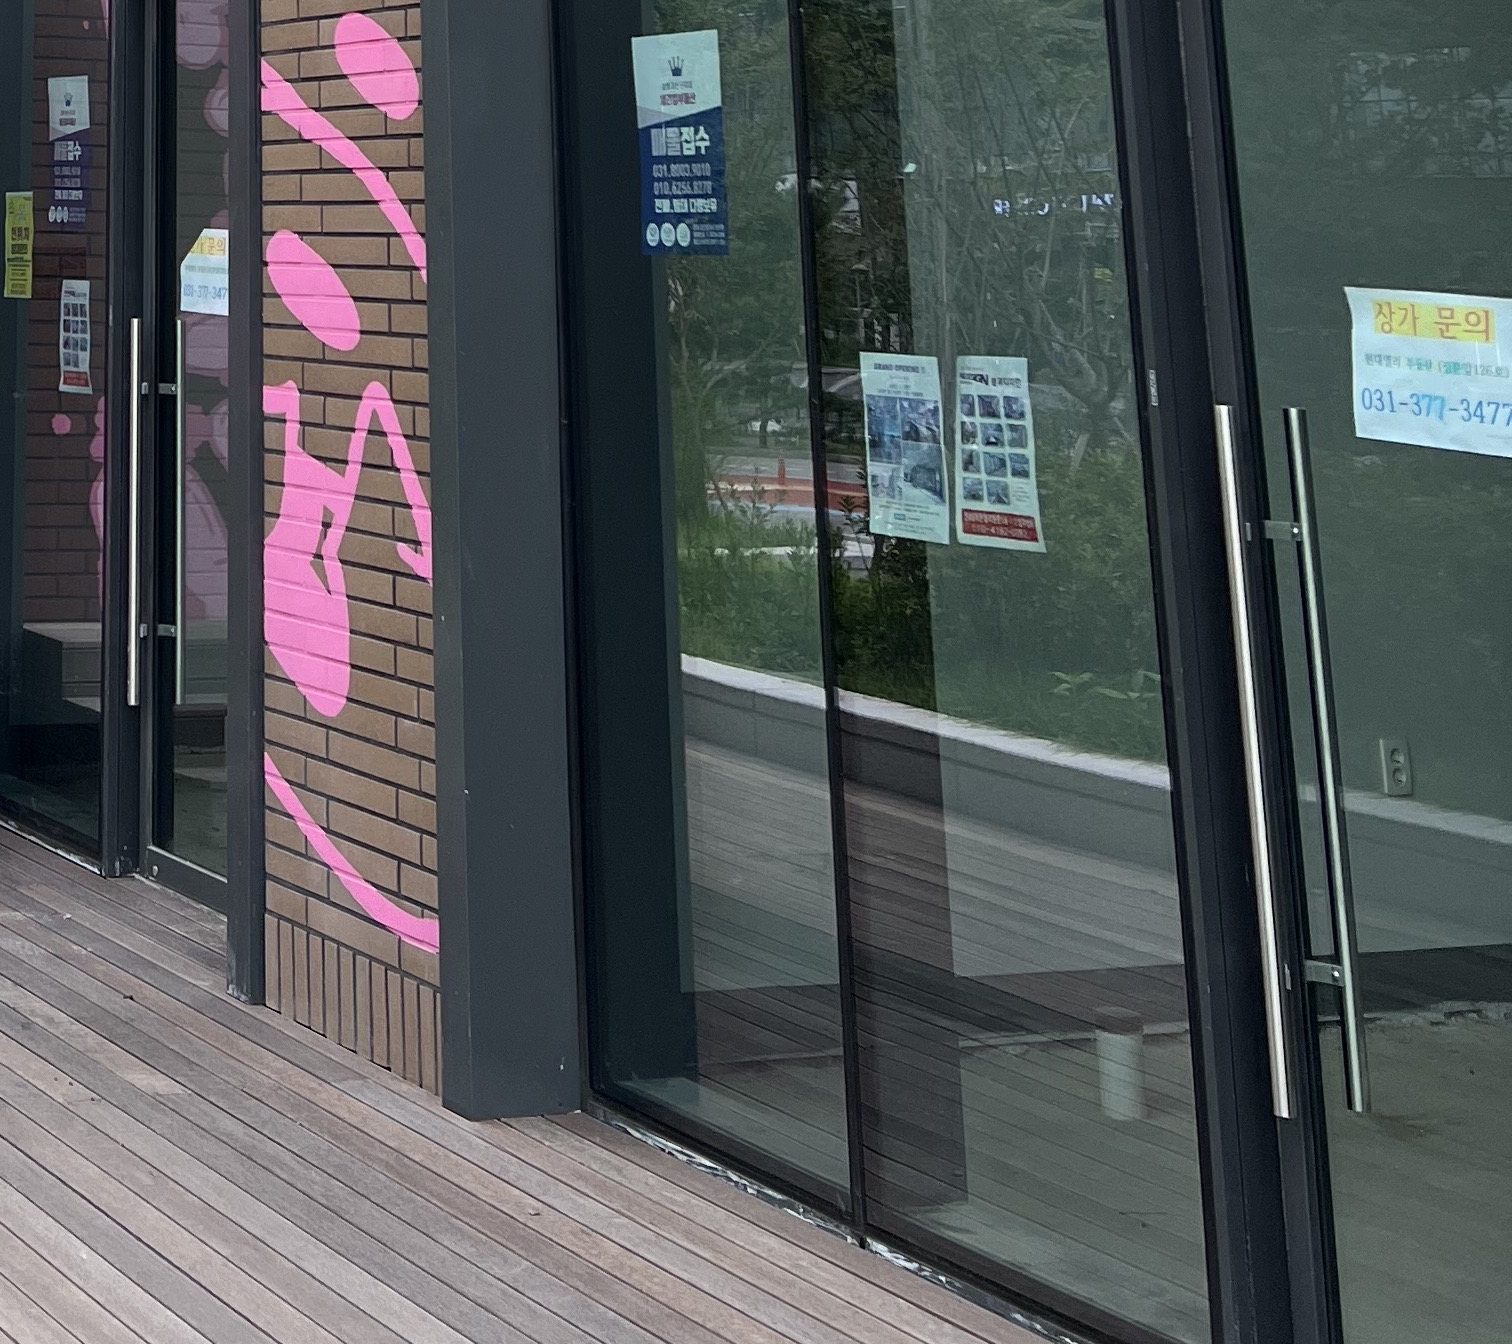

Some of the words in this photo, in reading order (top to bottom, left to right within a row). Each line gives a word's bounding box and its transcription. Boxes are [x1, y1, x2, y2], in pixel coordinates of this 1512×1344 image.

[1375, 301, 1419, 337] 상가
[1434, 306, 1491, 342] 문의
[1361, 387, 1512, 427] 031-377-3477
